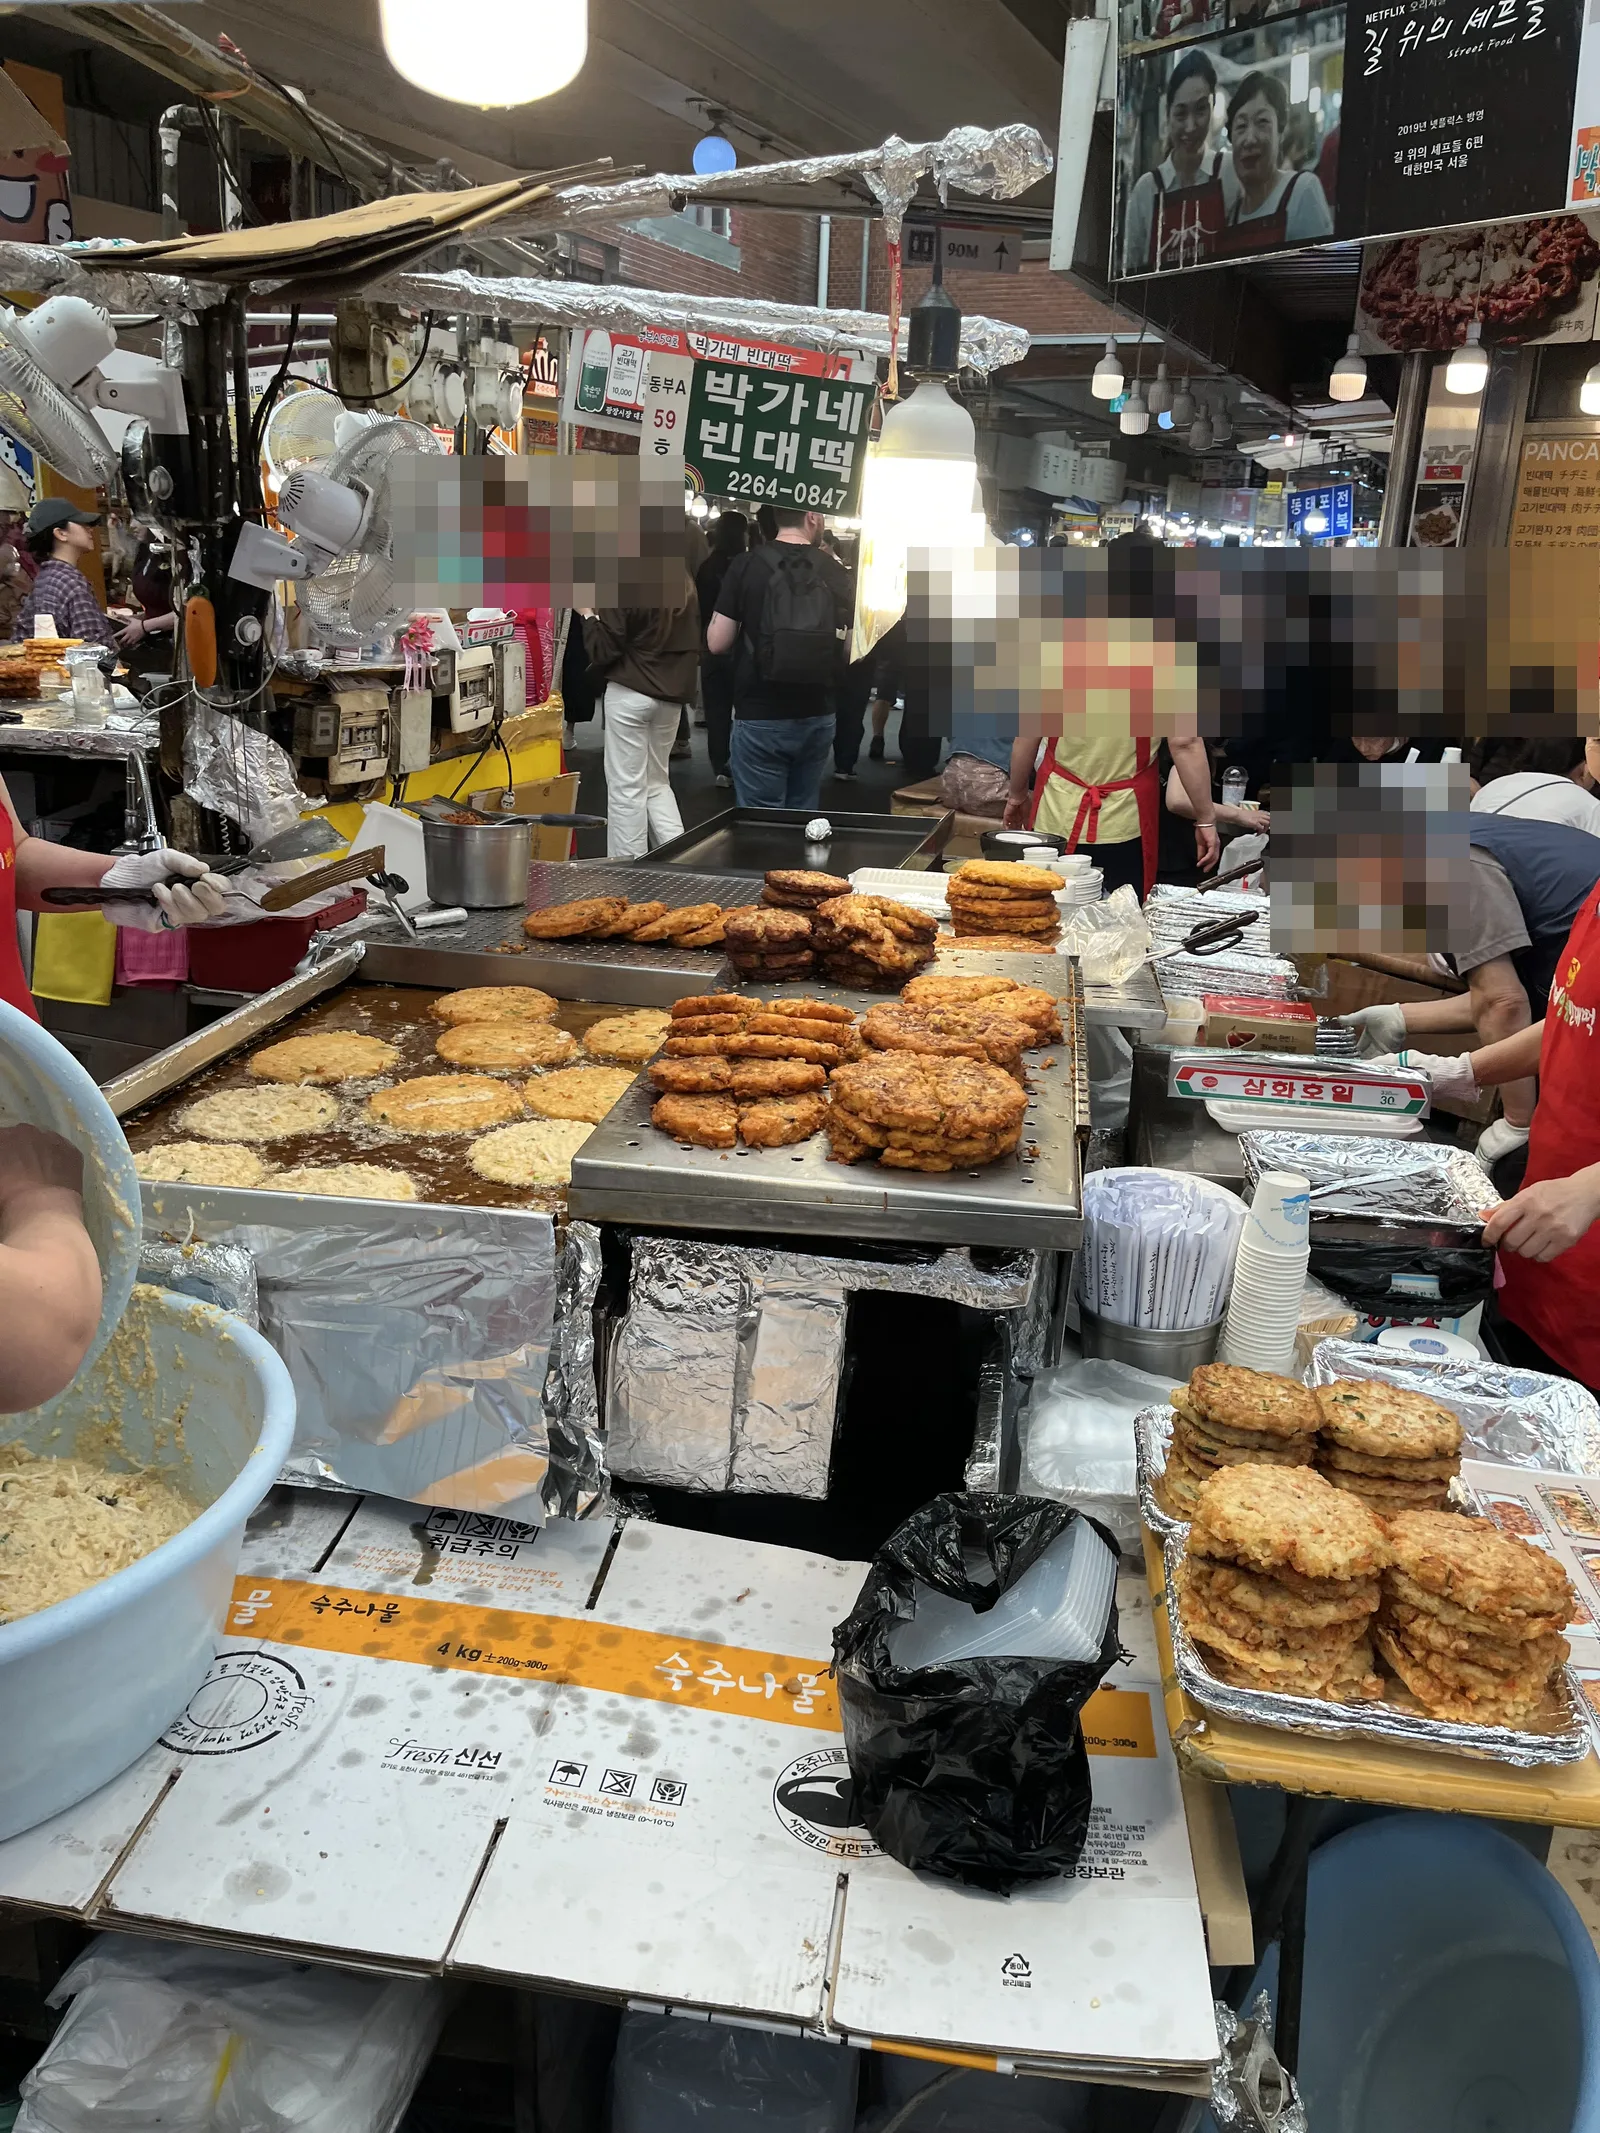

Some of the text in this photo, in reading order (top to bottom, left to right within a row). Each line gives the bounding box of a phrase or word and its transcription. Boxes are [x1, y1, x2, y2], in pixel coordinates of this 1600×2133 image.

[1365, 5, 1405, 24] NETFLIX
[1364, 27, 1389, 76] 길
[1398, 15, 1453, 58] 위의
[1487, 34, 1515, 51] Food
[1398, 109, 1485, 136] 2019년 넷플릭스 방영
[1393, 151, 1403, 164] 길
[1407, 146, 1427, 161] 위의
[1466, 135, 1484, 150] 6편
[1403, 154, 1469, 177] 대한민국 서울
[947, 242, 979, 258] 90M
[621, 349, 635, 357] 고기
[695, 336, 792, 372] 박가네 빈대떡
[612, 386, 632, 397] 10,000
[649, 375, 686, 395] 동부A
[605, 406, 632, 419] 광장시장
[704, 369, 864, 435] 박가네
[653, 409, 676, 430] 59
[654, 438, 671, 455] 호
[699, 418, 855, 483] 빈대떡
[727, 470, 848, 510] 2264-0847
[1337, 489, 1349, 530] 전복
[1242, 1078, 1354, 1104] 삼화호일
[427, 1533, 521, 1561] 취급주의
[310, 1594, 401, 1624] 숙주나물
[437, 1643, 450, 1656] 4
[455, 1644, 483, 1662] kg
[654, 1652, 826, 1714] 숙주나물
[280, 1691, 315, 1730] fresh
[385, 1736, 503, 1770] fresh 신선
[796, 1749, 846, 1774] 숙주나물
[542, 1797, 579, 1811] 직사광선은
[581, 1804, 604, 1816] 피하고
[606, 1809, 636, 1822] 냉장보관
[789, 1817, 830, 1850] 사단법인
[1102, 1833, 1129, 1841] 461번길
[1009, 1962, 1024, 1971] 종이
